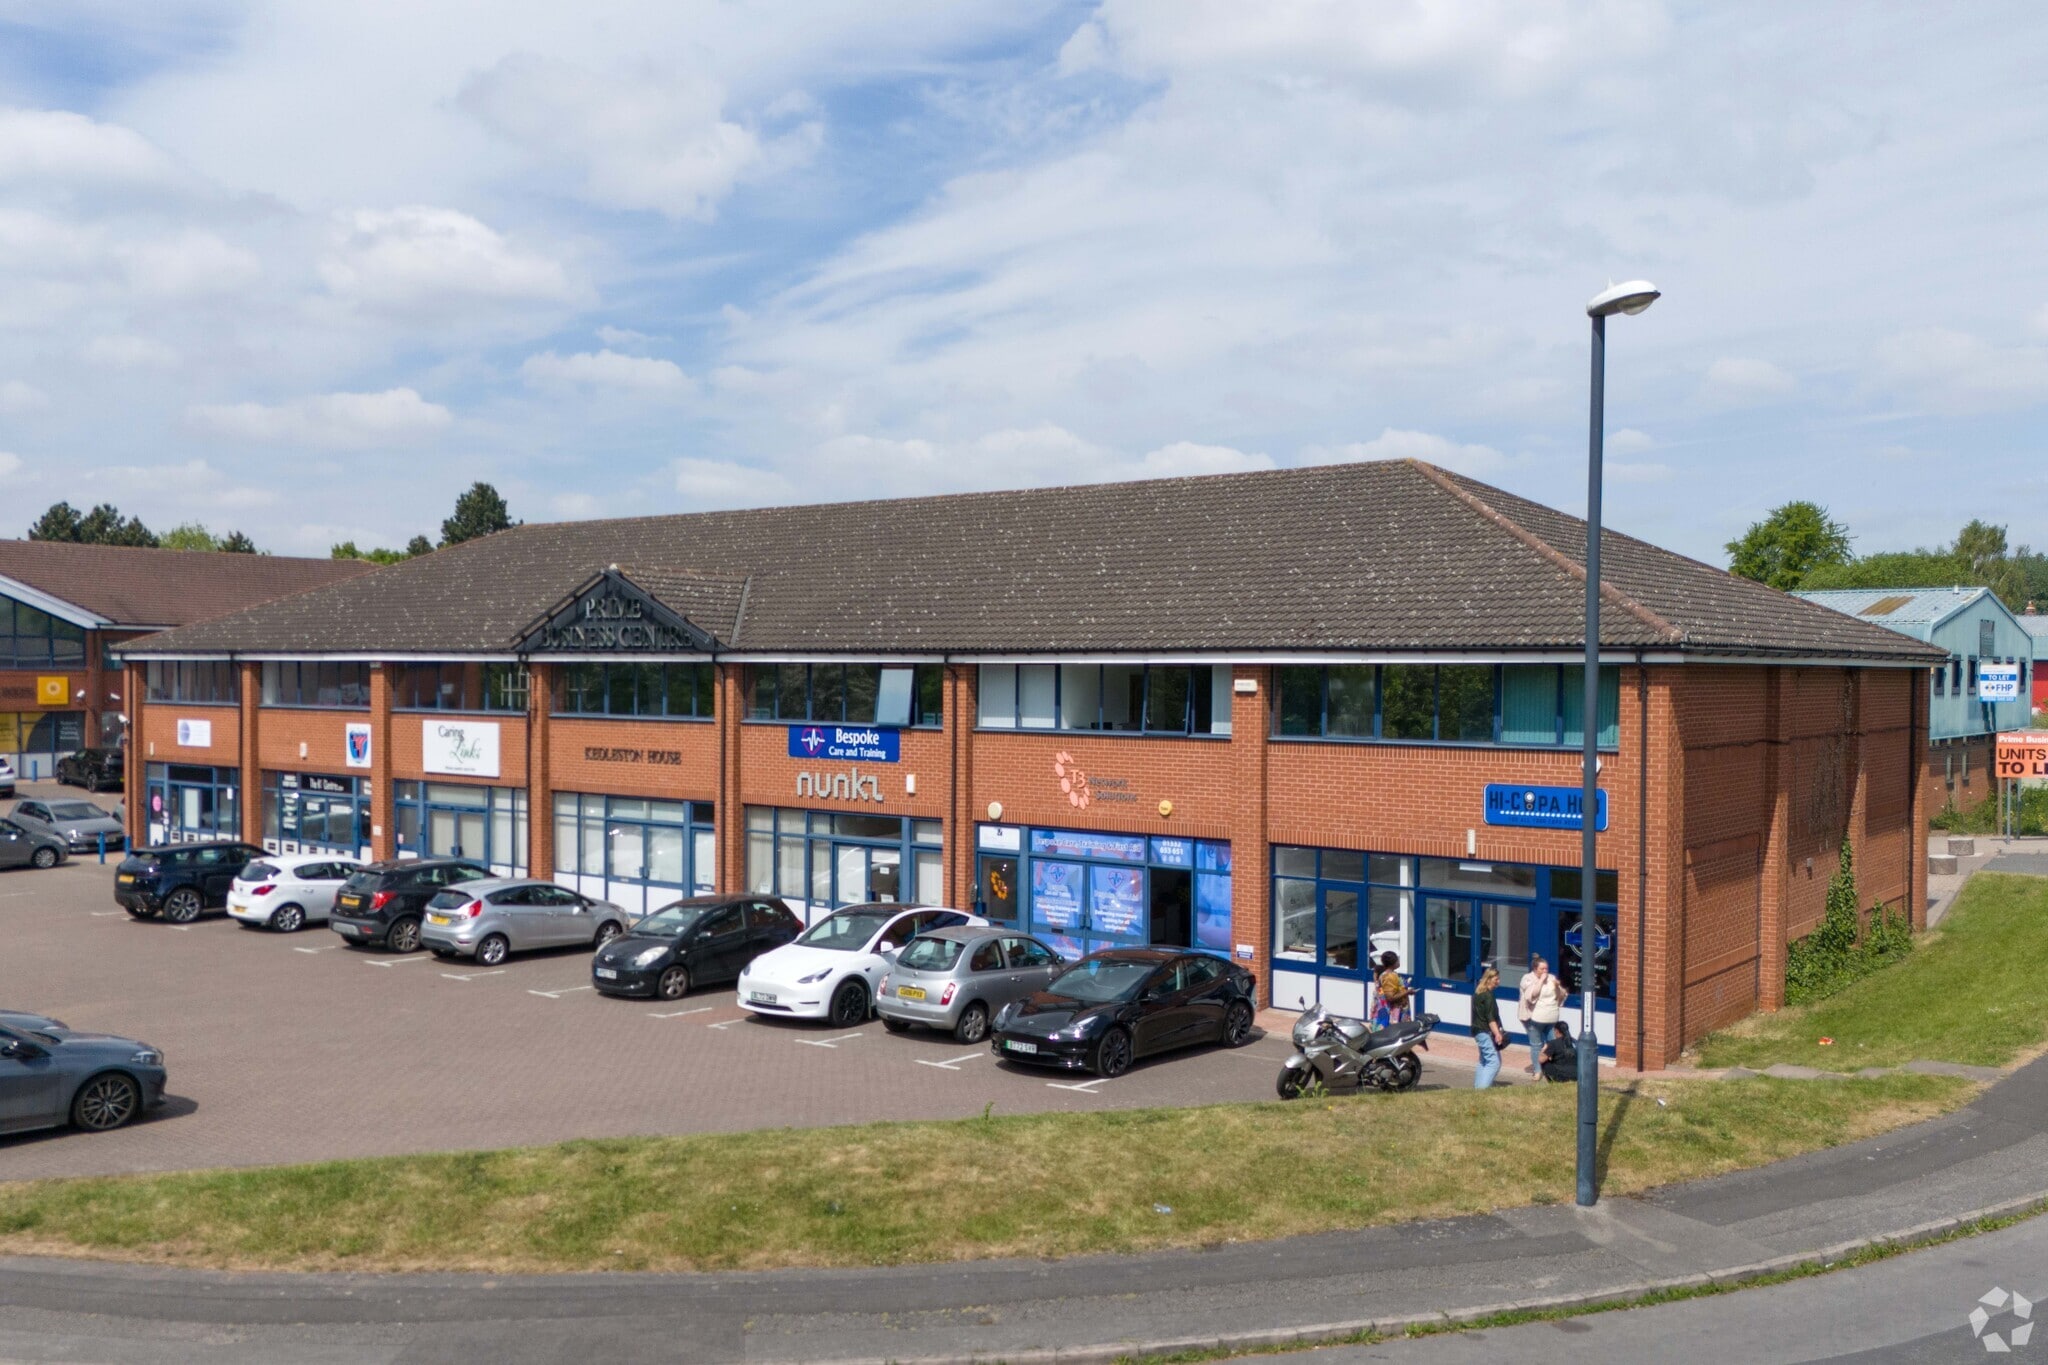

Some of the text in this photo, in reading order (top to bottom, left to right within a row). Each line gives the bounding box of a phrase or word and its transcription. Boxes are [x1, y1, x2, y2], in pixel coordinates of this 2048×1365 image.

[585, 598, 642, 619] PRIME
[618, 625, 695, 648] CENTRE
[1995, 684, 2014, 692] FHP
[438, 724, 465, 742] Caring
[835, 728, 880, 746] Bespoke
[1998, 735, 2024, 744] Prime
[584, 747, 682, 765] KEDLESTON HOUSE
[828, 746, 886, 760] Care and Training
[1998, 748, 2047, 761] UNITS
[1998, 762, 2025, 775] TO
[1070, 769, 1086, 788] T3
